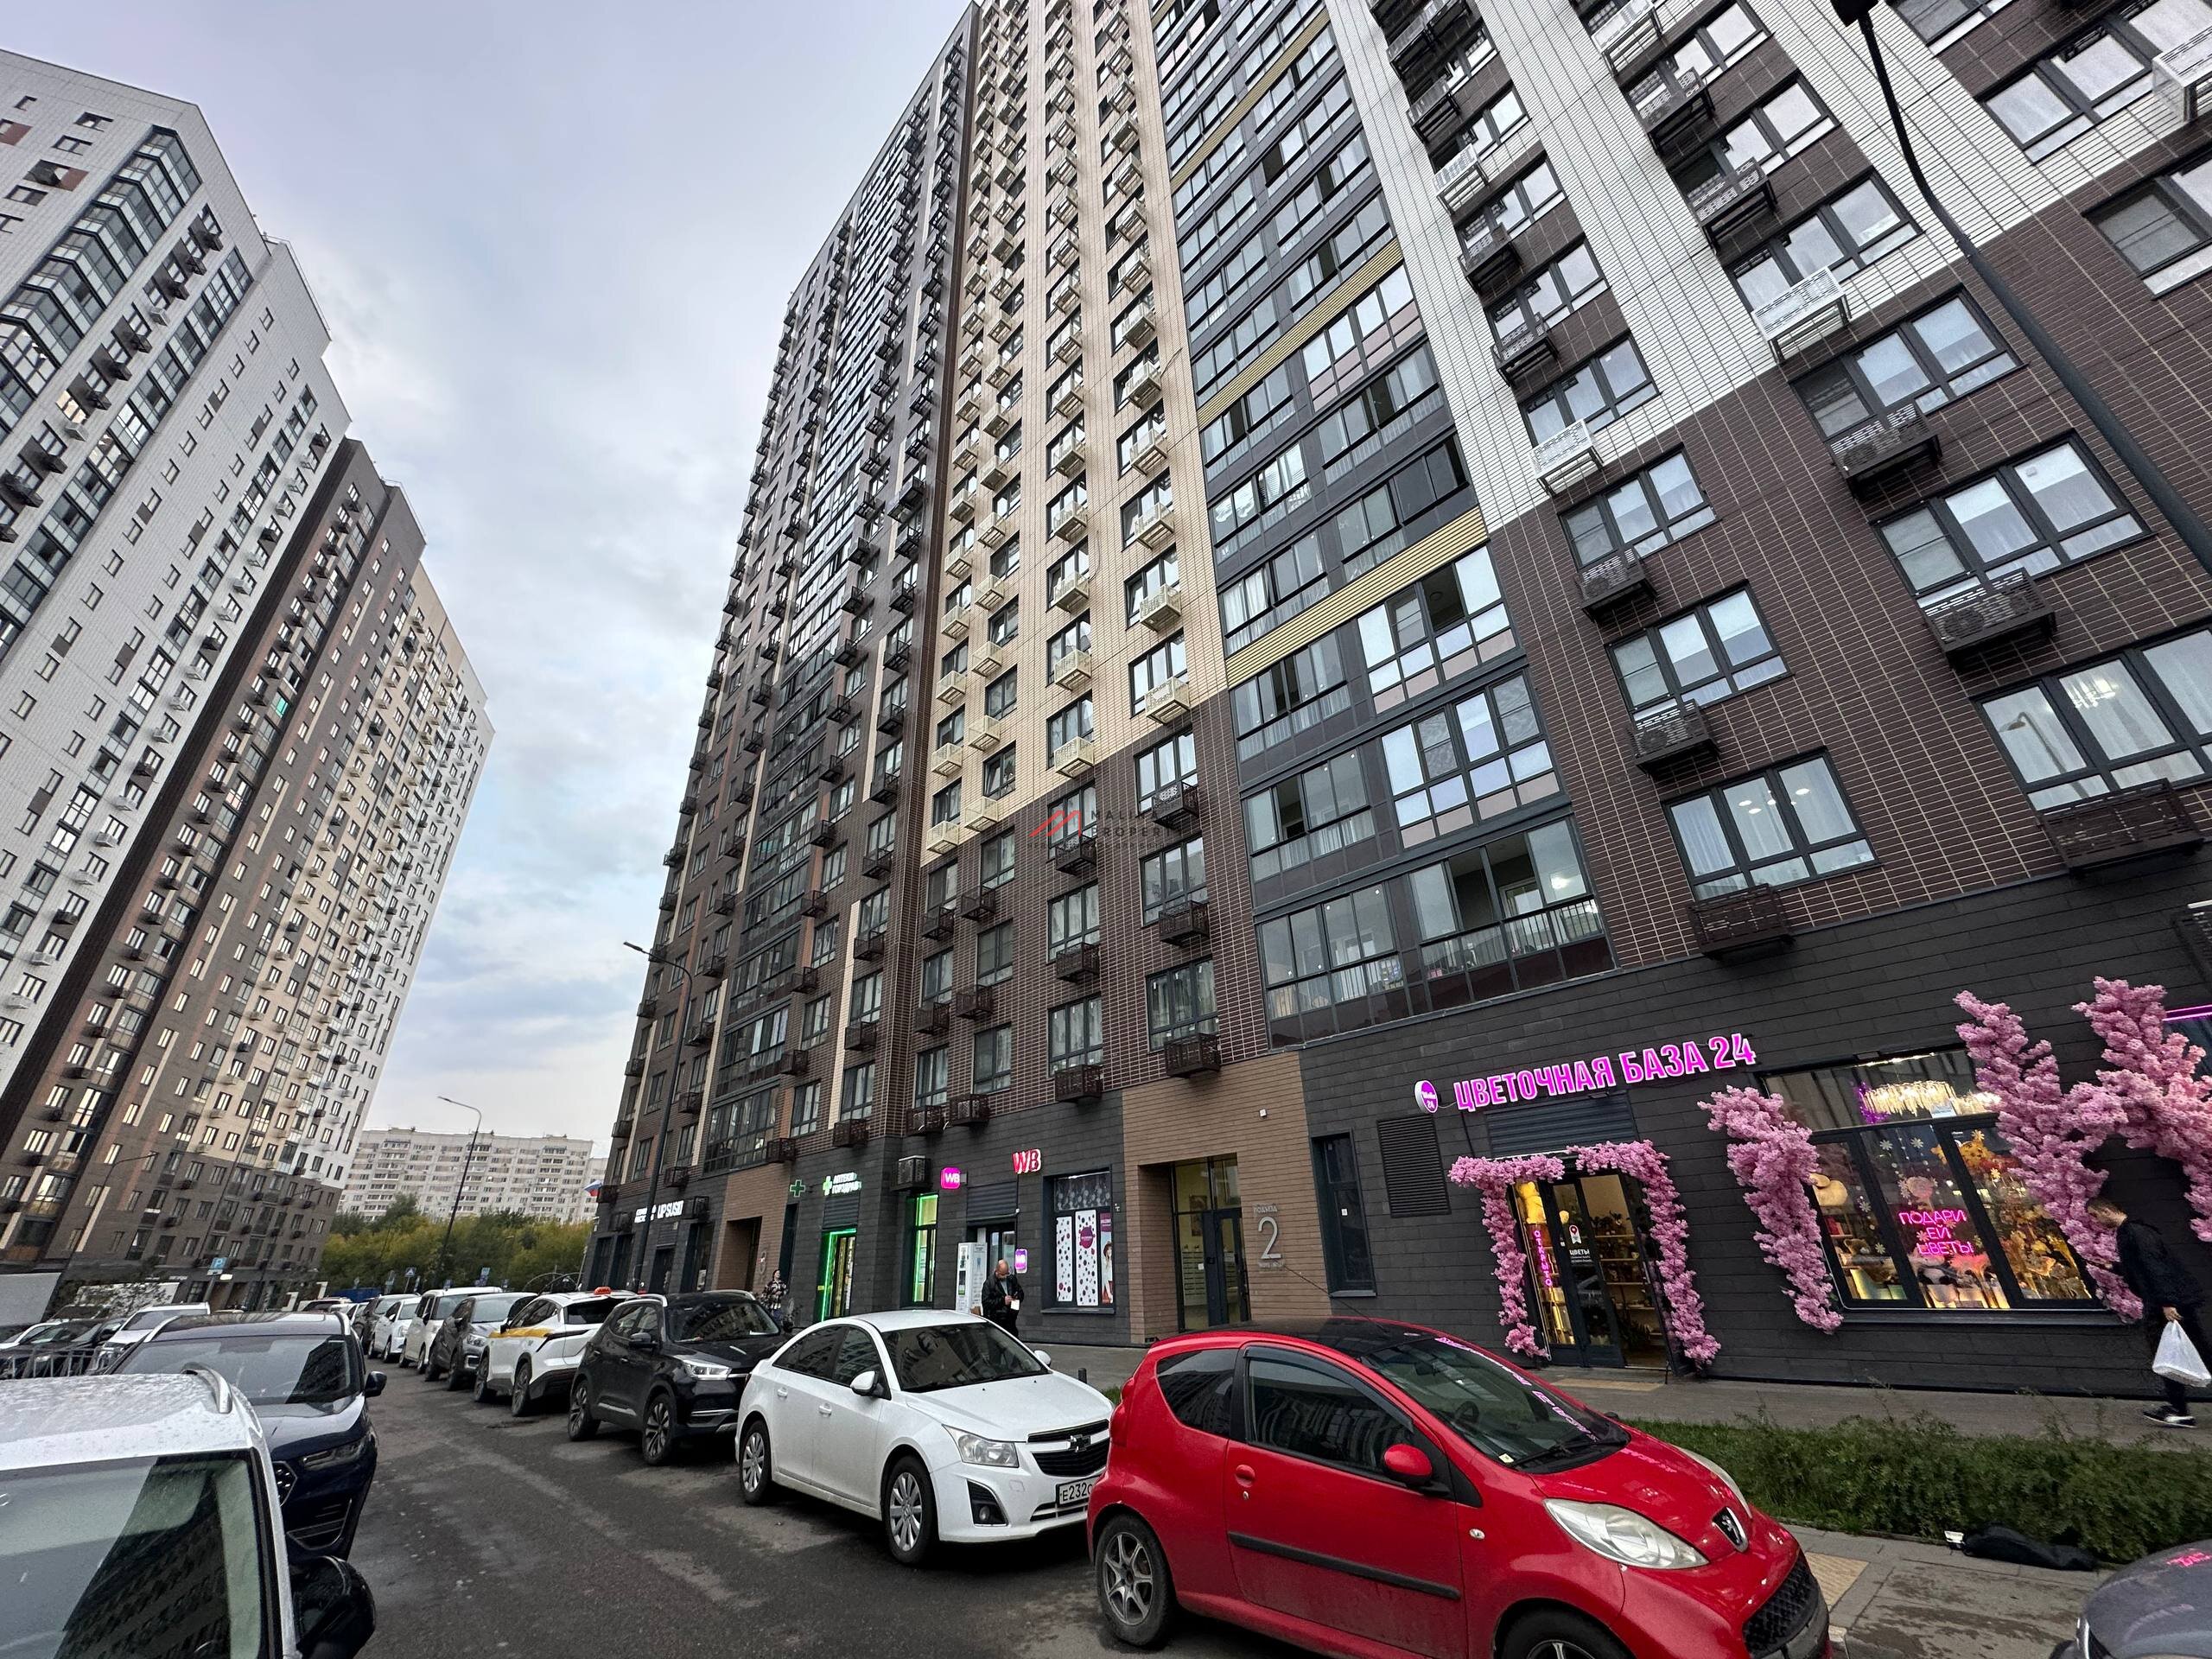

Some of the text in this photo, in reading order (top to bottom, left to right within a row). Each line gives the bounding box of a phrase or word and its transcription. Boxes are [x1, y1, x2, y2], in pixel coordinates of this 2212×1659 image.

[1453, 1033, 1757, 1112] ЦВЕТОЧНАЯ БАЗА 24
[1012, 1148, 1041, 1173] WB
[945, 1173, 960, 1183] WB
[1898, 1210, 1967, 1225] ПОДАРИ
[1258, 1217, 1281, 1259] 2
[1926, 1224, 1951, 1239] ЕЙ
[1916, 1241, 1974, 1255] ЦВЕТЫ
[1534, 1230, 1553, 1287] ОТКРЫТО
